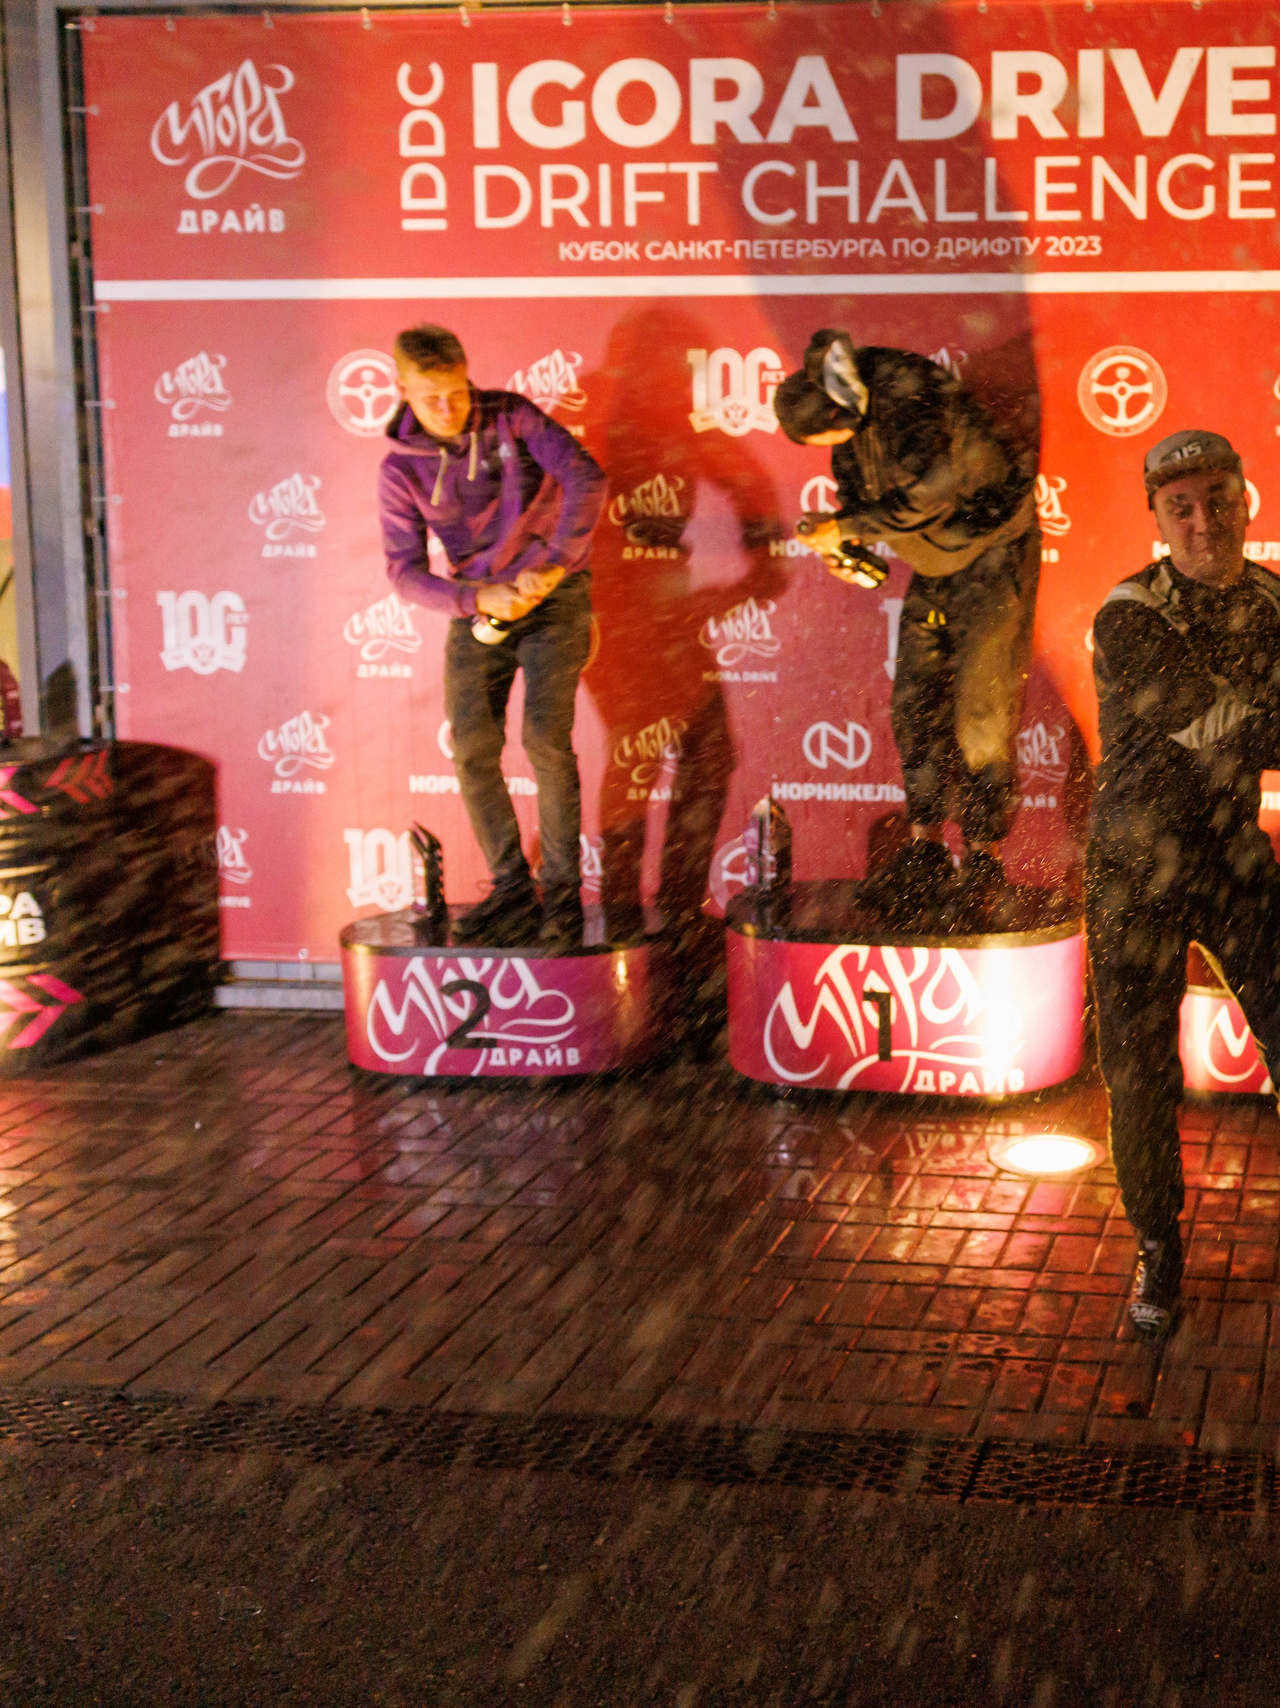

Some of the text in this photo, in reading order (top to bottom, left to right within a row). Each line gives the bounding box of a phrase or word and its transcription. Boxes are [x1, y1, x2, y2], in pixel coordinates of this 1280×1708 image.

[472, 45, 1277, 150] IGORA DRIVE
[397, 61, 448, 231] IDDC
[176, 203, 286, 234] ДРАЙВ
[473, 152, 1277, 230] DRIFT CHALLENGE
[558, 235, 1102, 262] КУБОК САНКТ-ПЕТЕРБУРГА ПО ДРИФТУ 2023
[772, 782, 907, 802] НОРНИКЕЛЬ
[439, 979, 498, 1048] 2
[863, 990, 892, 1062] 1
[489, 1043, 581, 1067] ДРАЙВ
